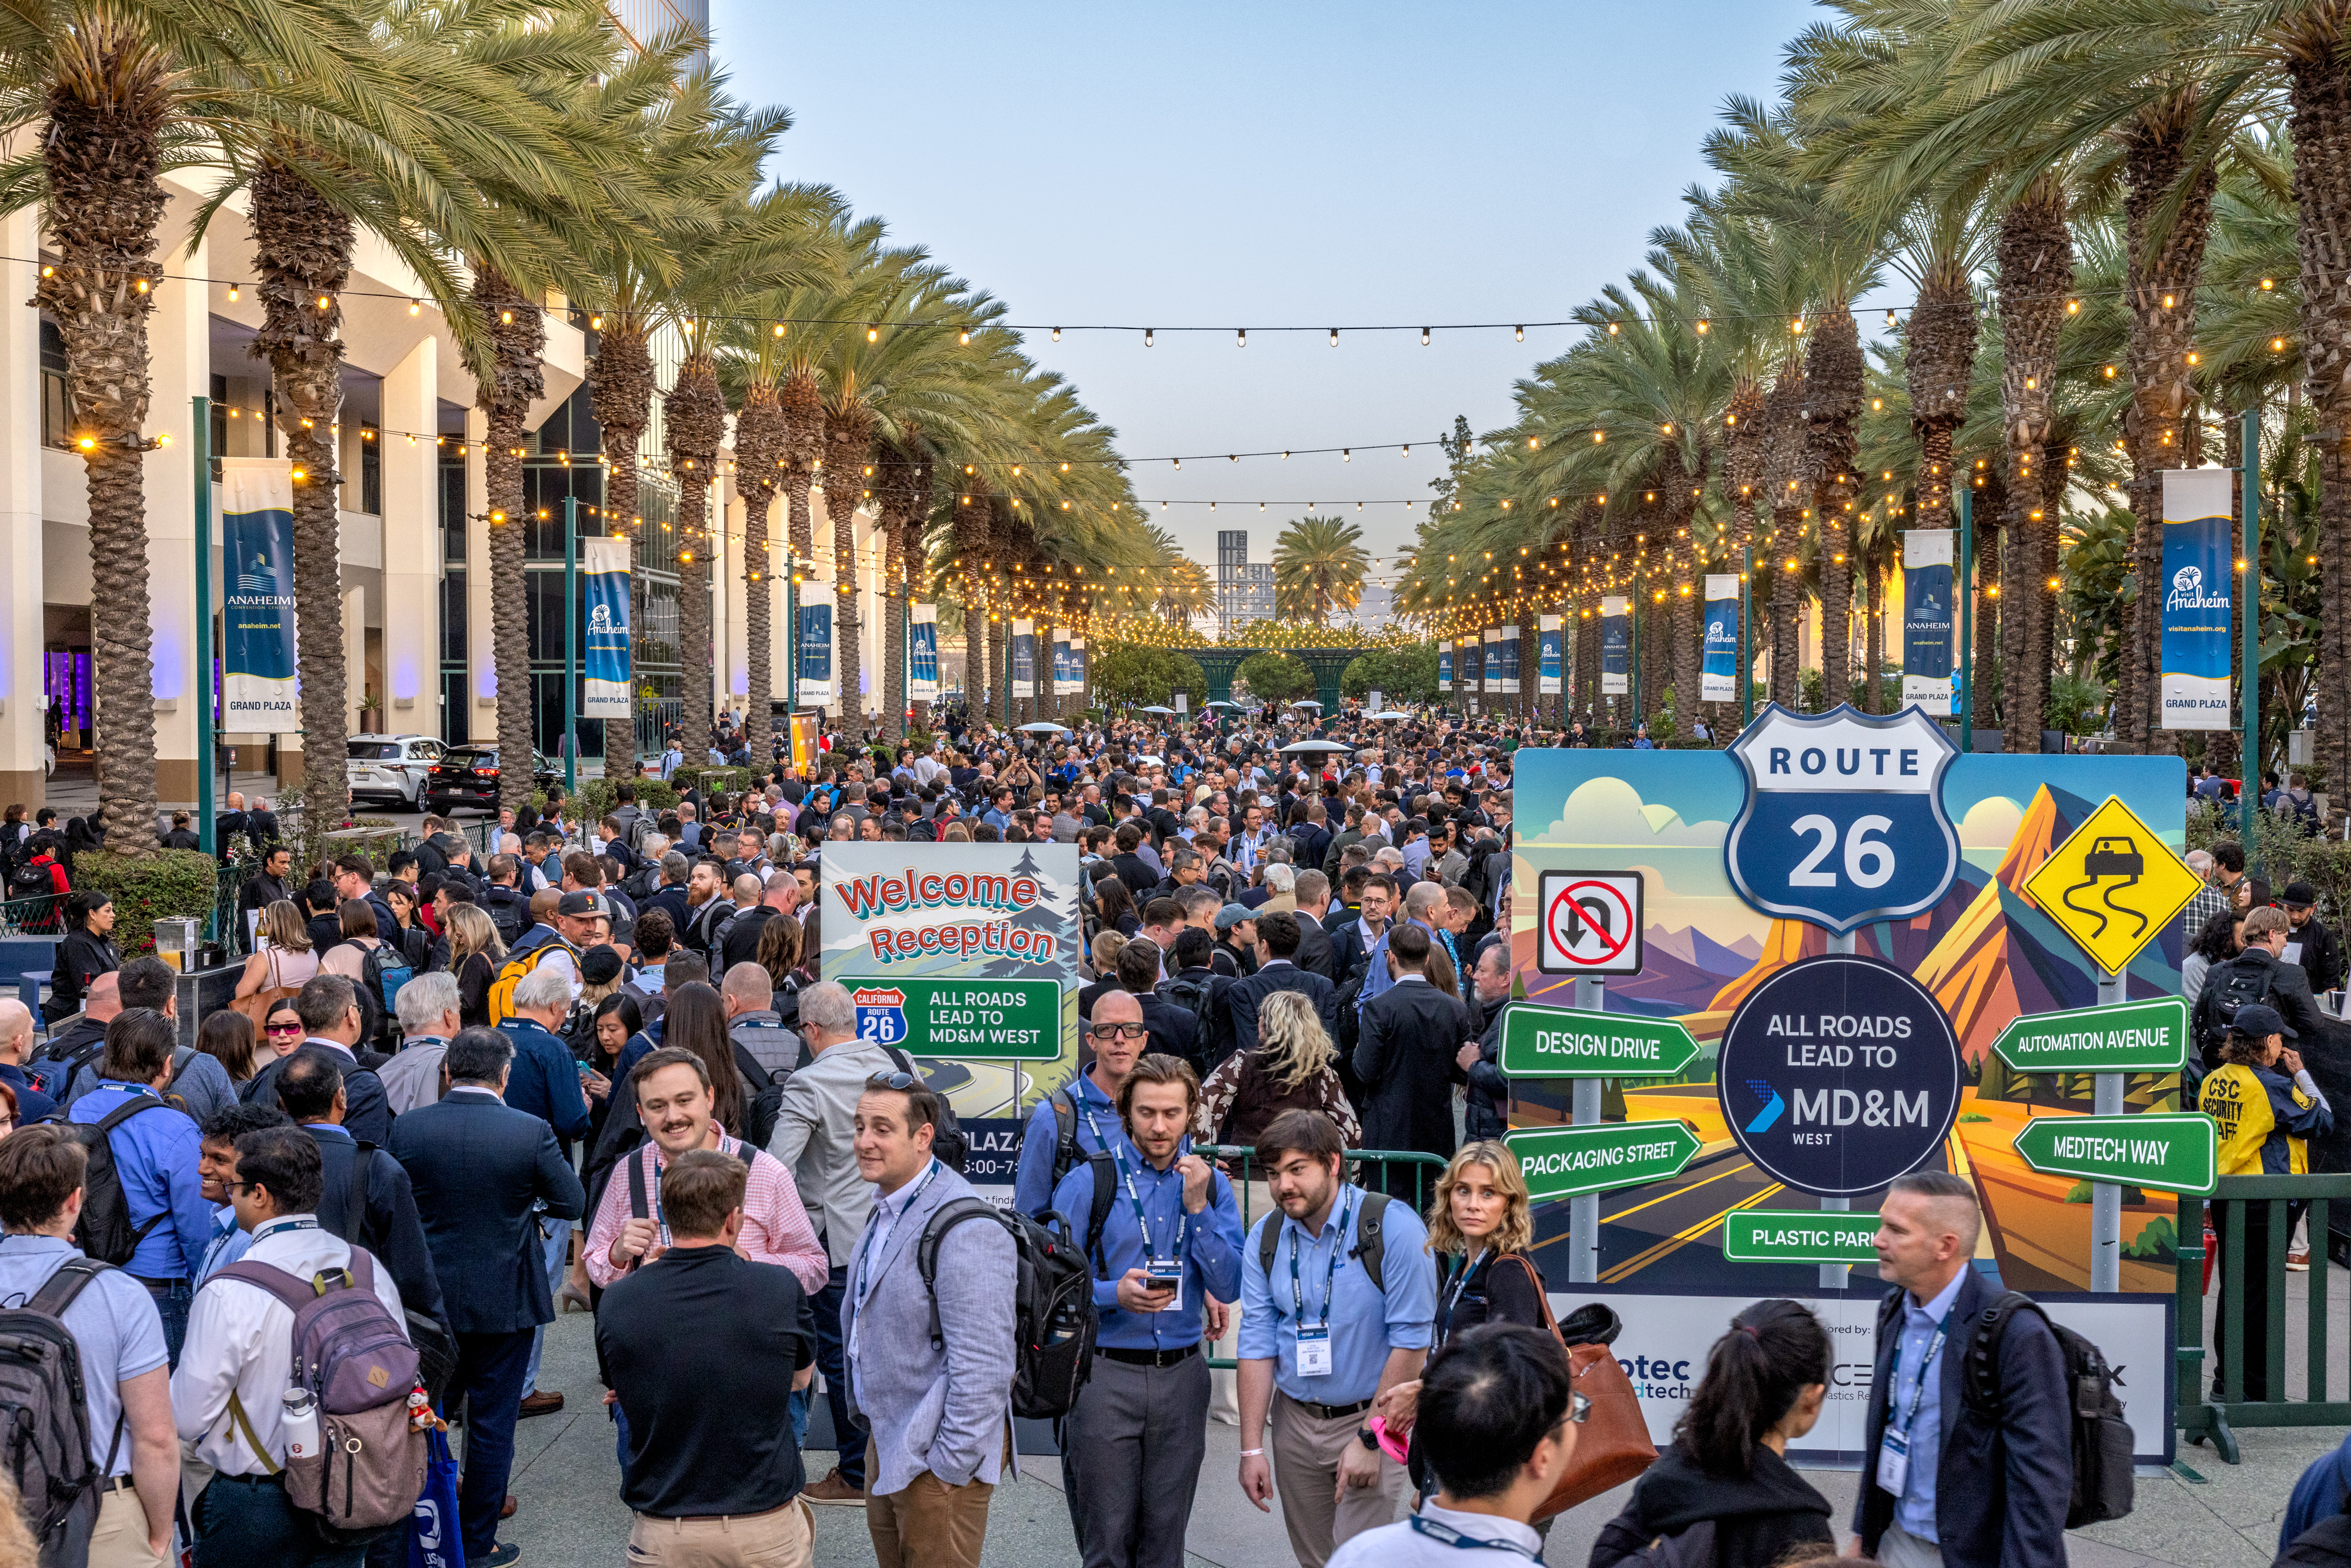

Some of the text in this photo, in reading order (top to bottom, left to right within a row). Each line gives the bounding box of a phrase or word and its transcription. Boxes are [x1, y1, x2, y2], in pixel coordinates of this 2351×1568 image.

[227, 595, 291, 605] ANAHEIM
[2166, 585, 2231, 612] Anaheim
[588, 618, 629, 636] Anaheim
[1706, 631, 1736, 644] Anaheim
[913, 646, 936, 656] Anaheim
[230, 701, 292, 710] GRAND PLAZA
[2166, 699, 2227, 708] GRAND PLAZA
[1770, 747, 1918, 776] ROUTE
[1789, 814, 1895, 889] 26
[833, 868, 1040, 920] Welcome
[869, 921, 1056, 964] Reception
[857, 994, 899, 1004] CALIFORNIA
[929, 991, 1027, 1007] ALL ROADS
[930, 1010, 1003, 1024] LEAD TO
[1766, 1014, 1911, 1038] ALL ROADS
[863, 1016, 894, 1041] 26
[930, 1028, 1040, 1044] MD&M WEST
[1536, 1031, 1660, 1060] DESIGN DRIVE
[2018, 1027, 2169, 1053] AUTOMATION AVENUE
[1787, 1044, 1897, 1067] LEAD TO
[2209, 1077, 2240, 1099] CSC
[1793, 1088, 1928, 1127] MD&M
[2203, 1097, 2243, 1121] SECURITY
[1793, 1133, 1833, 1145] WEST
[2217, 1120, 2238, 1141] AFF
[1521, 1141, 1677, 1177] PACKAGING STREET
[2054, 1135, 2169, 1165] MEDTECH WAY
[1753, 1229, 1830, 1247] PLASTIC
[1854, 1325, 1871, 1336] by:
